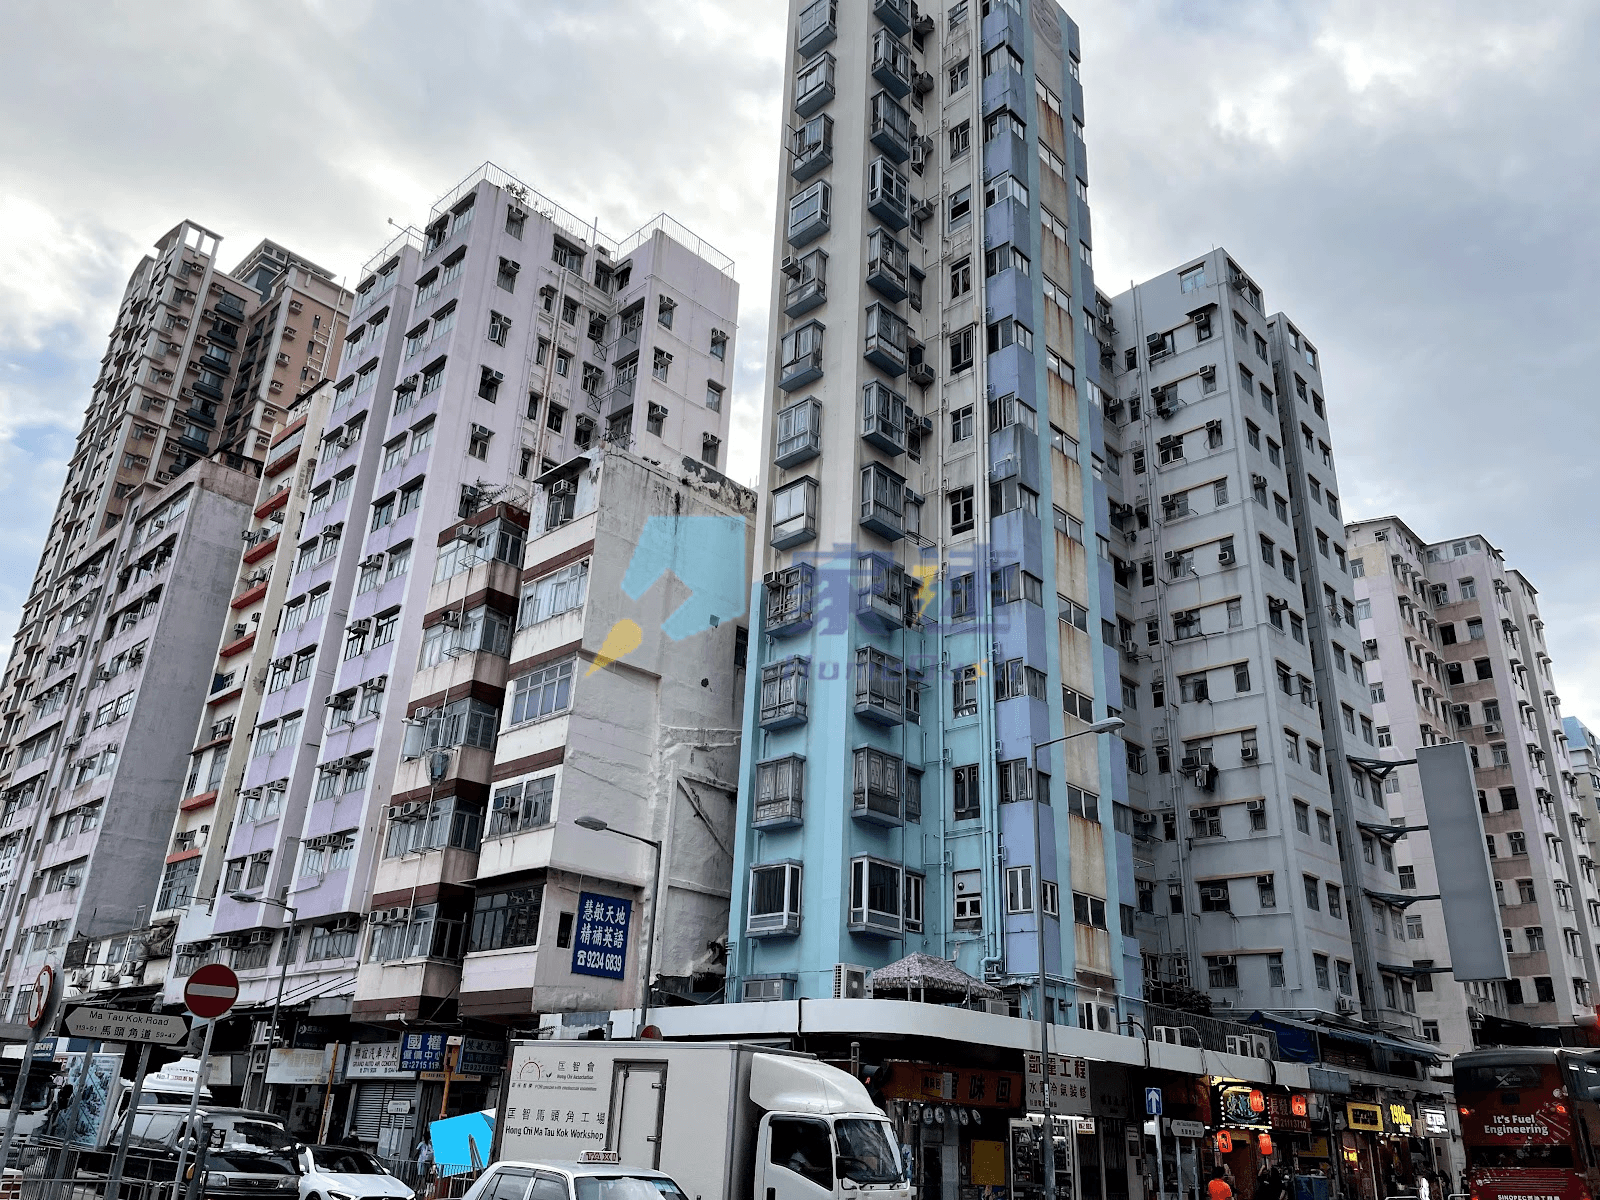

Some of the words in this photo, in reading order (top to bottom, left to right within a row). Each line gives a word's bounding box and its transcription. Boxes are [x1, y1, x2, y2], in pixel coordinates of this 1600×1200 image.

[583, 900, 626, 925] 慧敏天地
[580, 923, 624, 948] 精補英語
[587, 951, 604, 969] 9234
[605, 954, 622, 972] 6839
[89, 1010, 103, 1020] Ma
[107, 1012, 124, 1022] Tau
[126, 1014, 143, 1024] Kok
[145, 1016, 170, 1026] Road
[100, 1025, 152, 1040] 馬頭角道
[407, 1034, 442, 1050] 國權
[558, 1060, 595, 1072] 匡智會
[507, 1107, 606, 1125] 匡智馬頭角工場
[1493, 1115, 1510, 1124] It's
[1512, 1114, 1535, 1124] Fuel
[505, 1125, 522, 1137] Hong
[523, 1126, 533, 1136] Chi
[533, 1127, 543, 1136] Ma
[544, 1127, 555, 1137] Tau
[556, 1128, 568, 1138] Kok
[570, 1129, 604, 1142] Workshop
[1484, 1124, 1549, 1136] Engineering
[586, 1152, 617, 1161] TAXI
